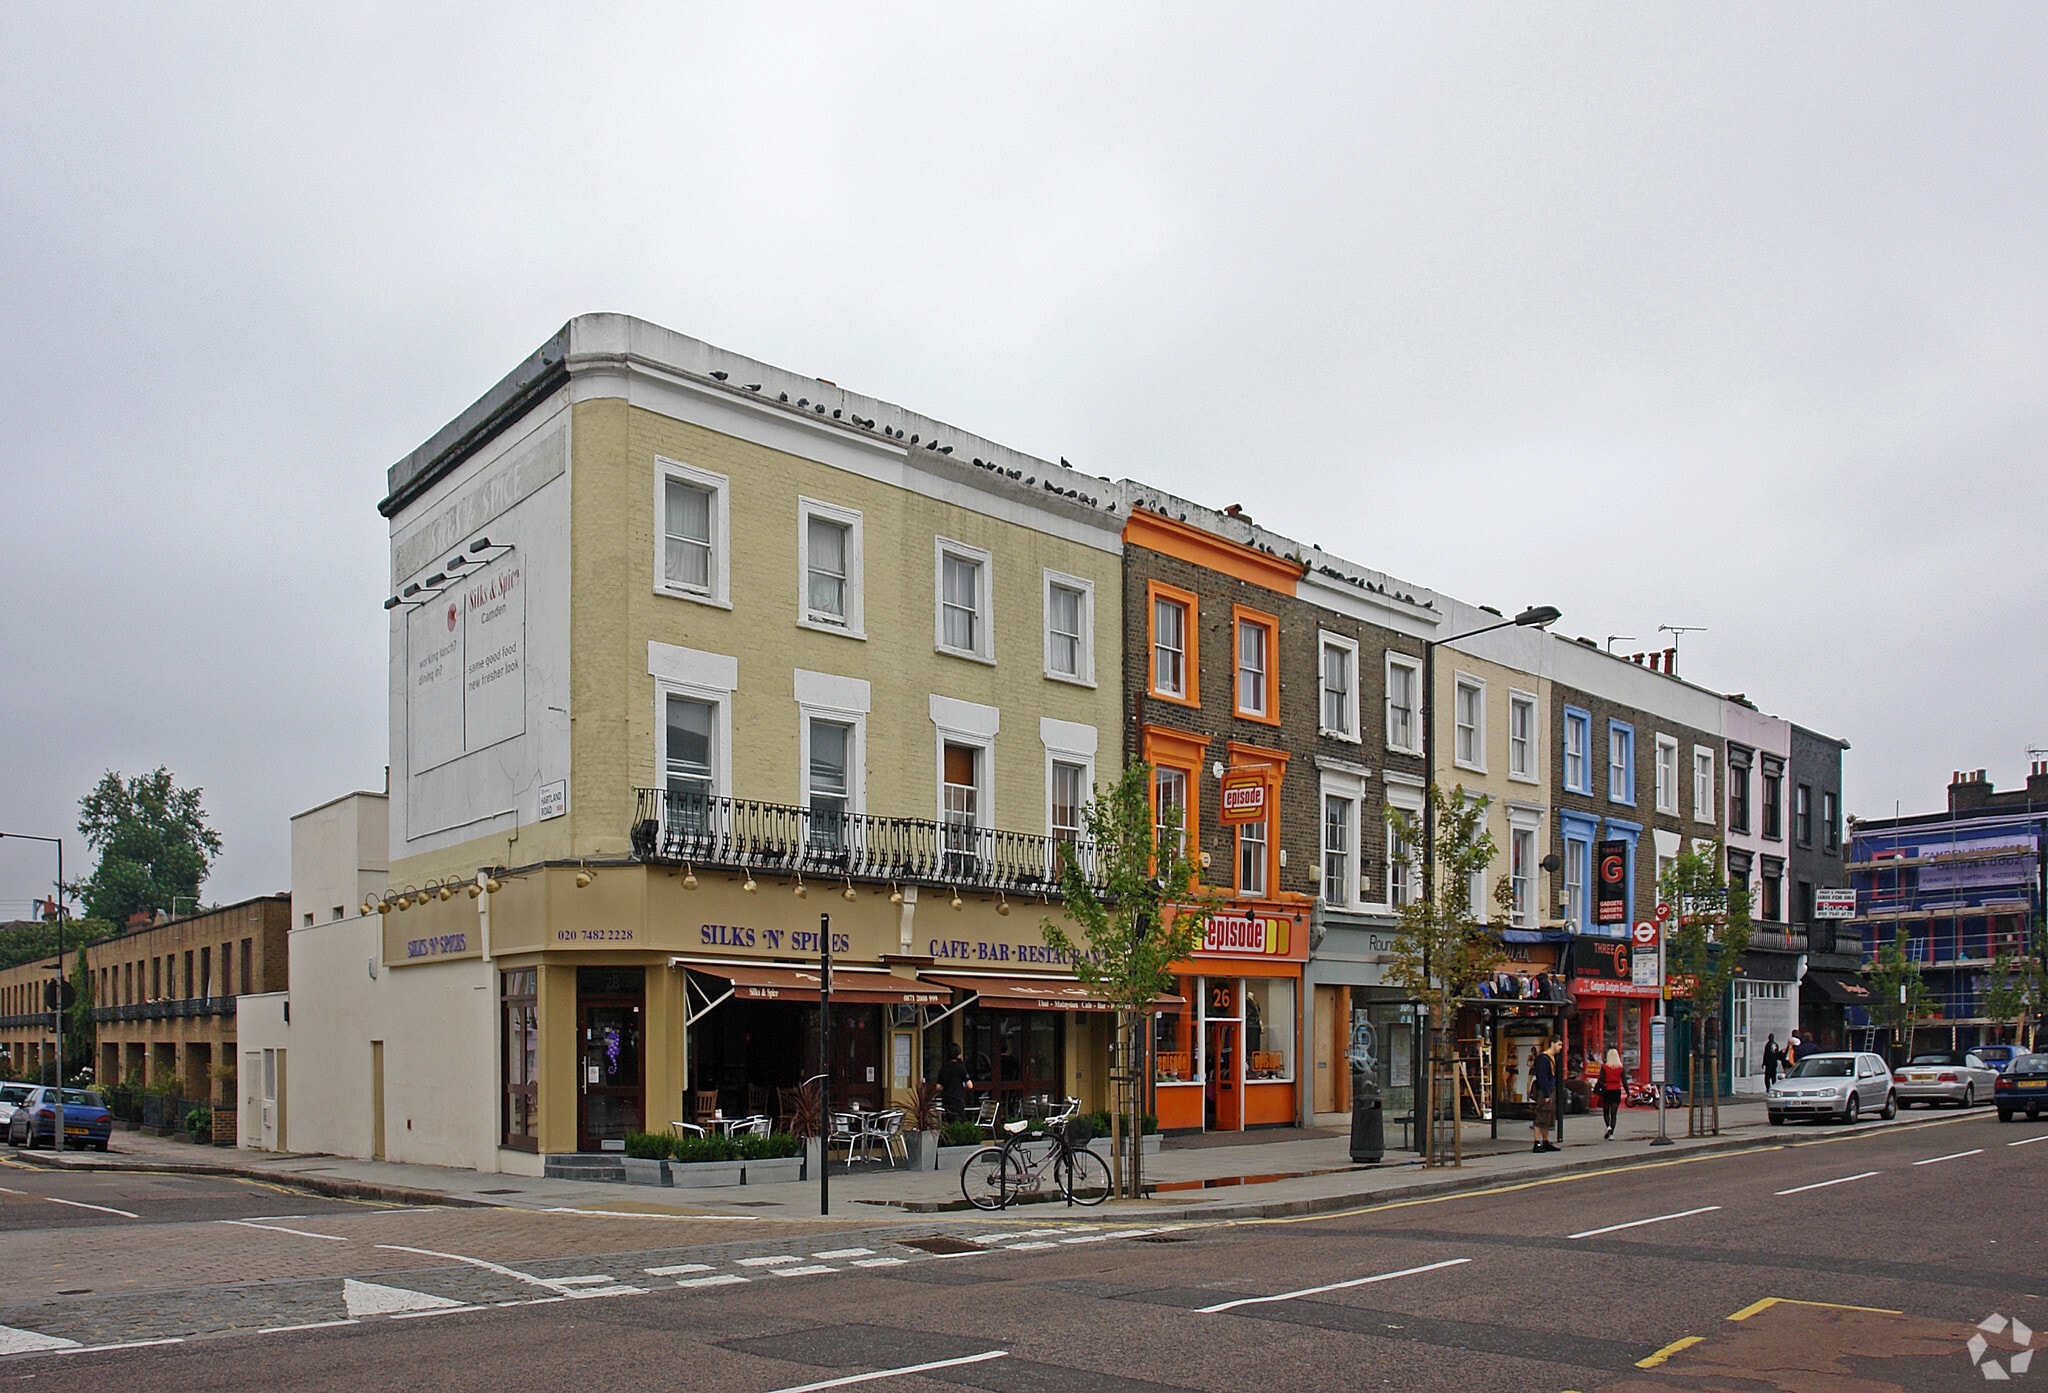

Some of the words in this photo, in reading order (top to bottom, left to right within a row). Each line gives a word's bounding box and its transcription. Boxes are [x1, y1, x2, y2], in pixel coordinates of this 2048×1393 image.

[469, 584, 488, 612] Silks
[489, 580, 496, 600] &
[498, 568, 519, 600] Spice
[481, 603, 507, 624] Camden
[419, 651, 439, 669] working
[439, 640, 457, 659] lunch?
[485, 648, 501, 668] good
[501, 641, 517, 659] food
[481, 666, 504, 686] fresher
[505, 659, 519, 674] look
[1226, 789, 1261, 807] episode
[541, 805, 552, 816] ROAD
[1601, 855, 1623, 883] G
[1657, 906, 1667, 915] CP
[1823, 902, 1849, 911] Bruce
[557, 930, 577, 941] 020
[581, 930, 605, 940] 7482
[608, 929, 633, 940] 2228
[701, 924, 755, 947] SILKS
[791, 931, 849, 952] SPIES
[1207, 919, 1263, 951] episode
[1594, 942, 1615, 955] THREE
[749, 987, 761, 998] Silks
[767, 987, 779, 999] Spice
[1213, 988, 1230, 1008] 26
